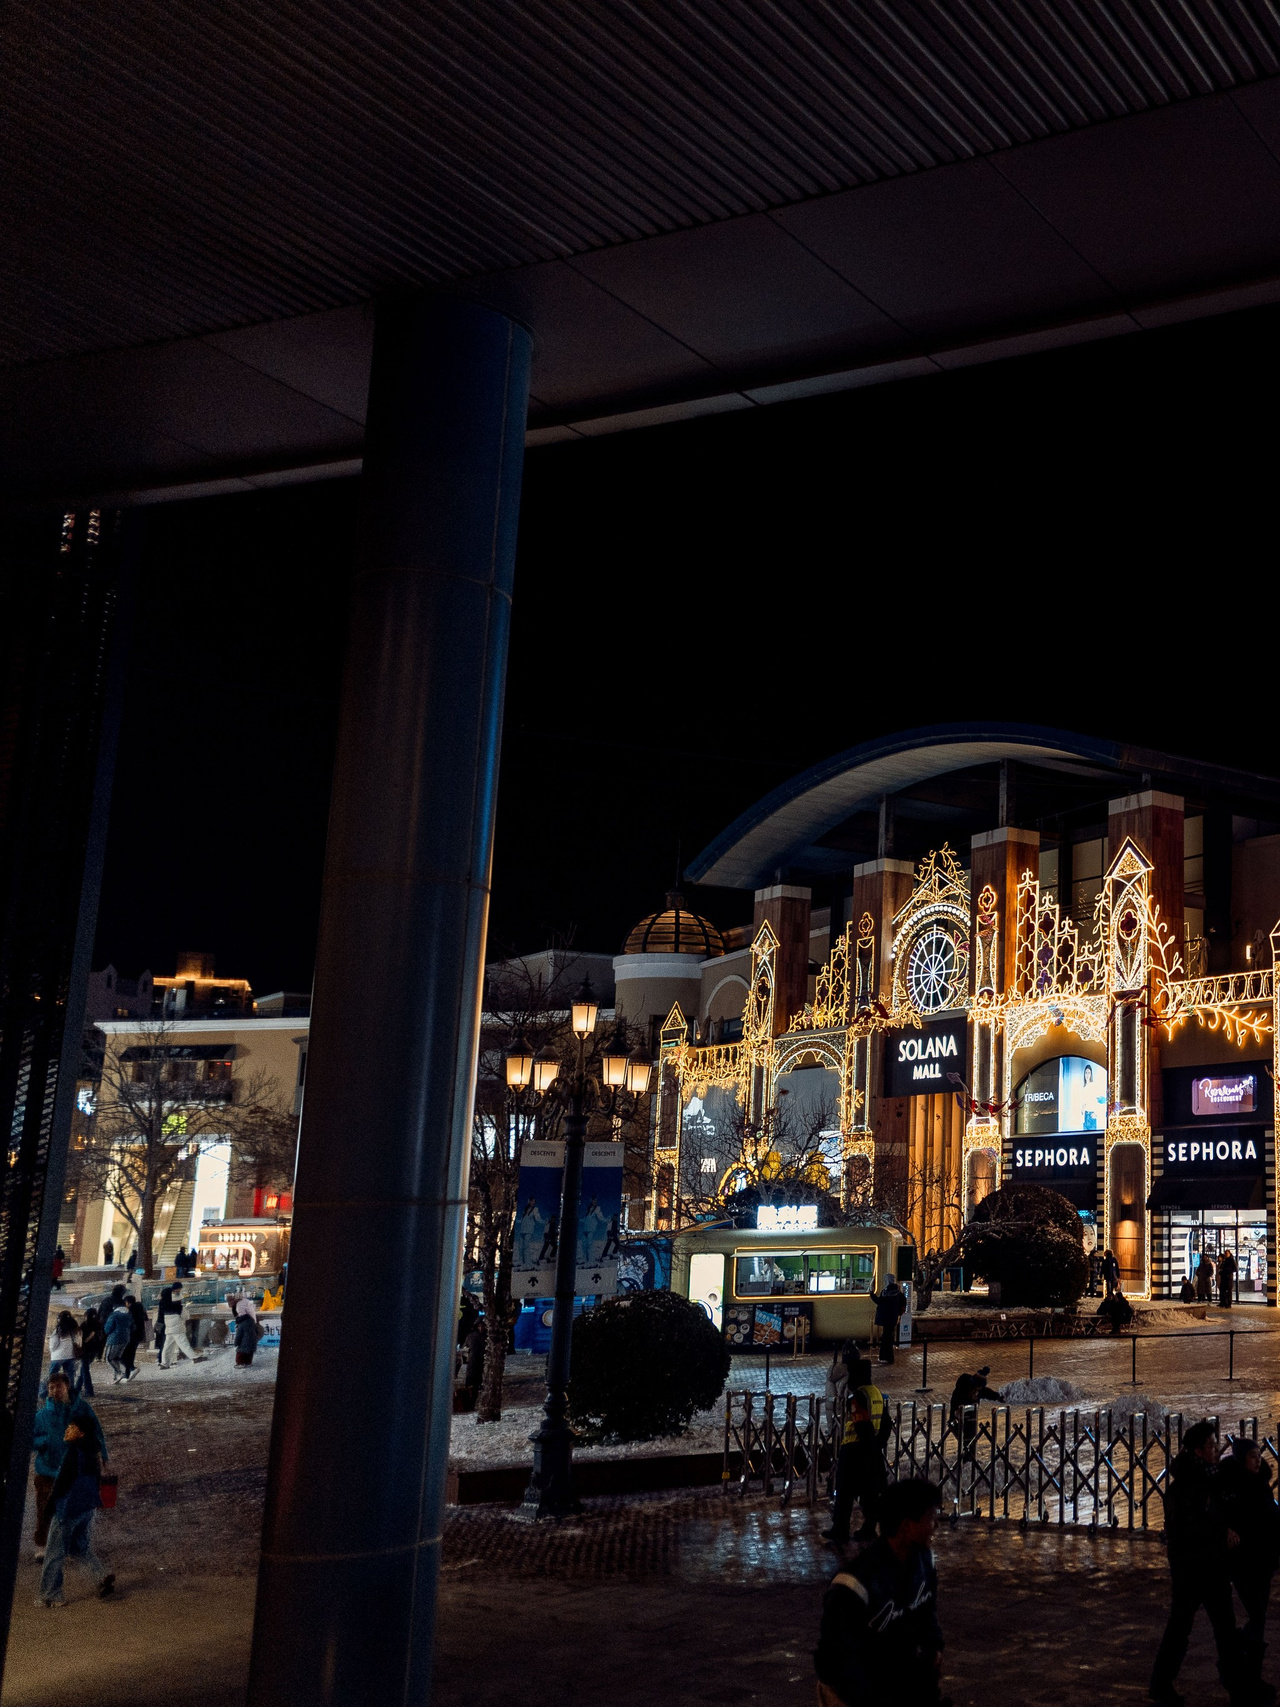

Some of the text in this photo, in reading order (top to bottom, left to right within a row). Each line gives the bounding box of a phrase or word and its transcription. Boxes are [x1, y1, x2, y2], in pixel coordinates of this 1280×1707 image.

[898, 1034, 958, 1062] SOLANA
[912, 1063, 942, 1080] MALL
[1016, 1147, 1090, 1167] SEPHORA
[1168, 1141, 1257, 1162] SEPHORA
